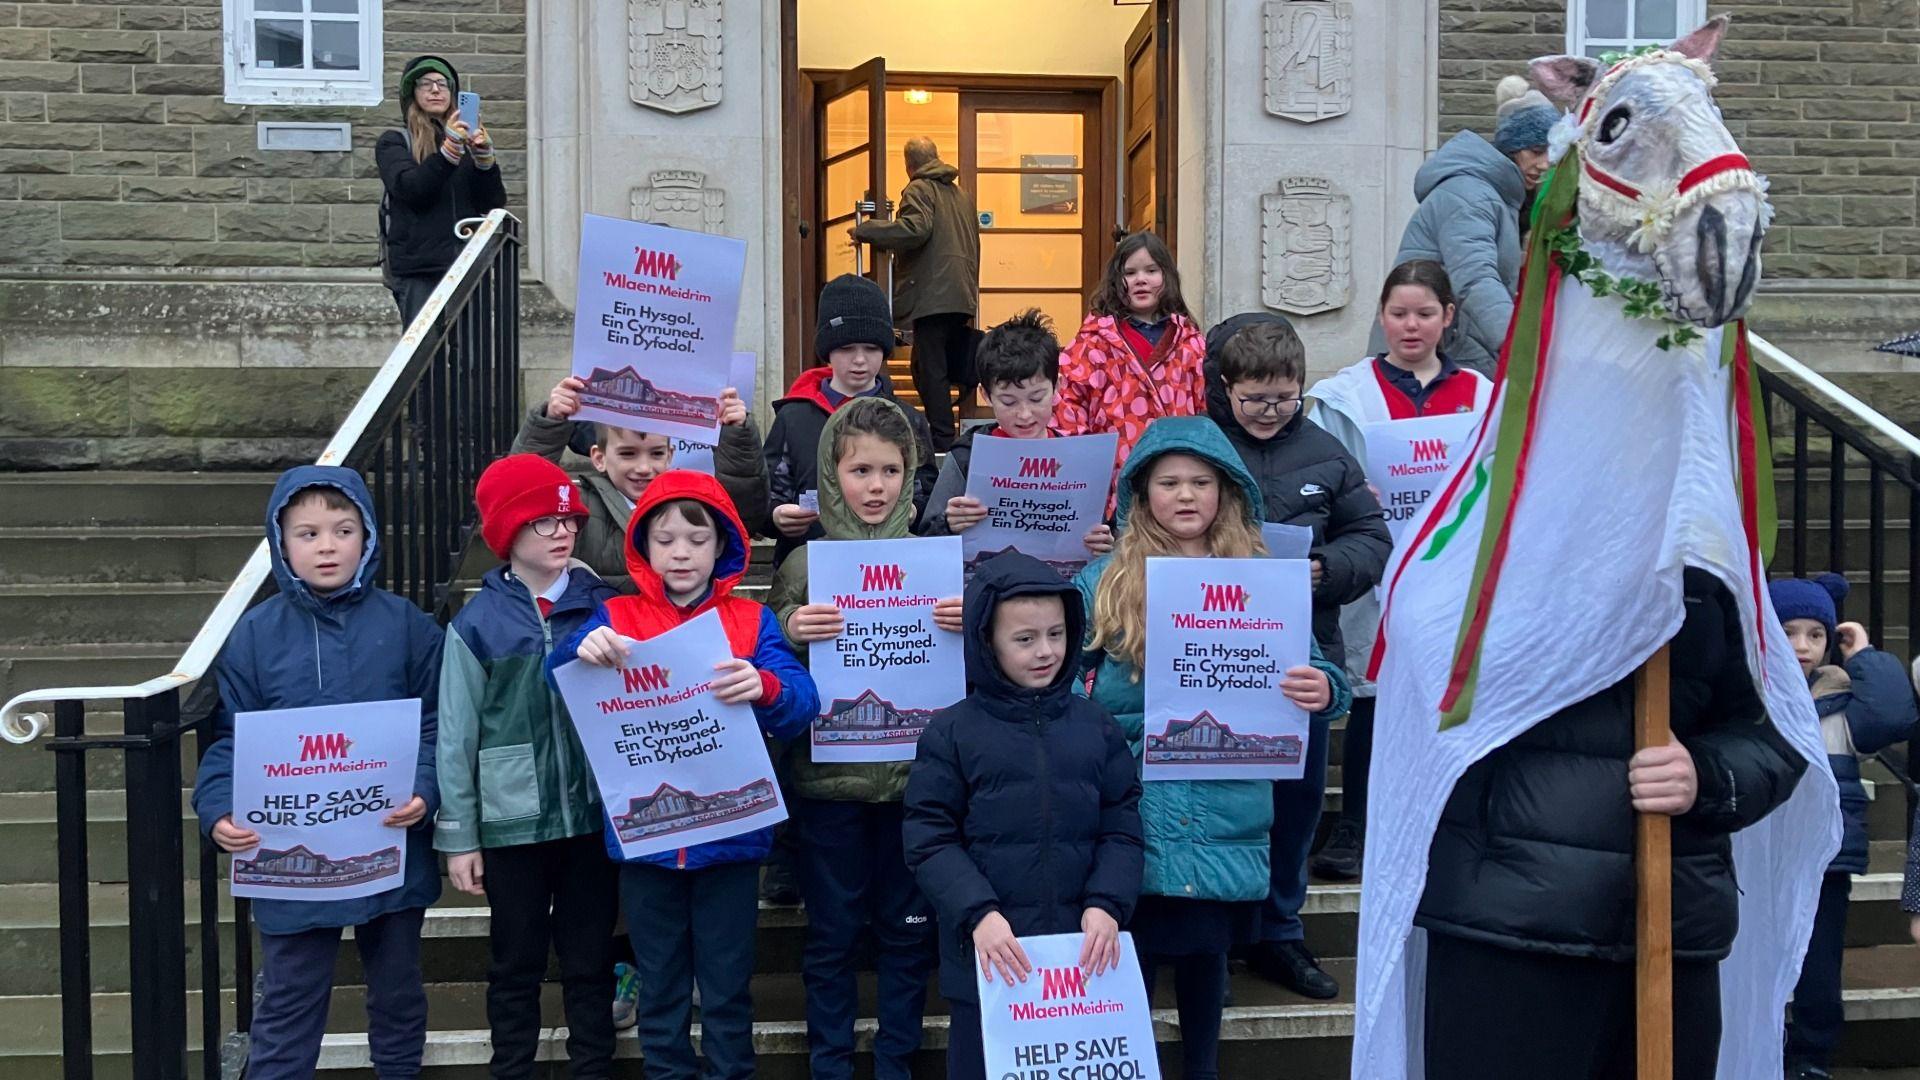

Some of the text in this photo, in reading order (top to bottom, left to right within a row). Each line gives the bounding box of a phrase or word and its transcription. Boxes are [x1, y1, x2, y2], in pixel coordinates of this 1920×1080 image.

[603, 272, 711, 302] 'Mlaen Meidrim
[614, 301, 695, 326] Ein Hysgol.
[602, 314, 704, 340] Ein Cymuned.
[607, 330, 695, 353] Ein Dyfodol.
[1388, 464, 1433, 476] 'Mlaen
[990, 477, 1086, 490] 'Mlaen Meidrim
[999, 498, 1071, 512] Ein Hysgol.
[1391, 490, 1431, 505] HELP
[988, 508, 1079, 522] Ein Cymuned.
[992, 518, 1070, 532] Ein Dyfodol.
[833, 595, 938, 609] 'Mlaen Meidrim
[847, 619, 925, 638] Ein Hysgol.
[1172, 614, 1283, 630] 'Mlaen Meidrim
[836, 635, 936, 655] Ein Cymuned.
[1185, 643, 1269, 661] Ein Hysgol.
[843, 653, 930, 670] Ein Dyfodol.
[1173, 659, 1280, 676] Ein Cymuned.
[1180, 675, 1272, 692] Ein Dyfodol.
[596, 698, 655, 714] 'Mlaen
[621, 709, 709, 737] Ein Hysgol.
[614, 719, 725, 754] Ein Cymuned.
[627, 738, 723, 767] Ein Dyfodol.
[264, 759, 387, 777] 'Mlaen Meidrim
[264, 785, 384, 809] HELP SAVE
[247, 799, 395, 826] OUR SCHOOL
[1009, 1000, 1123, 1020] 'Mlaen Meidrim
[1015, 1036, 1129, 1067] HELP SAVE
